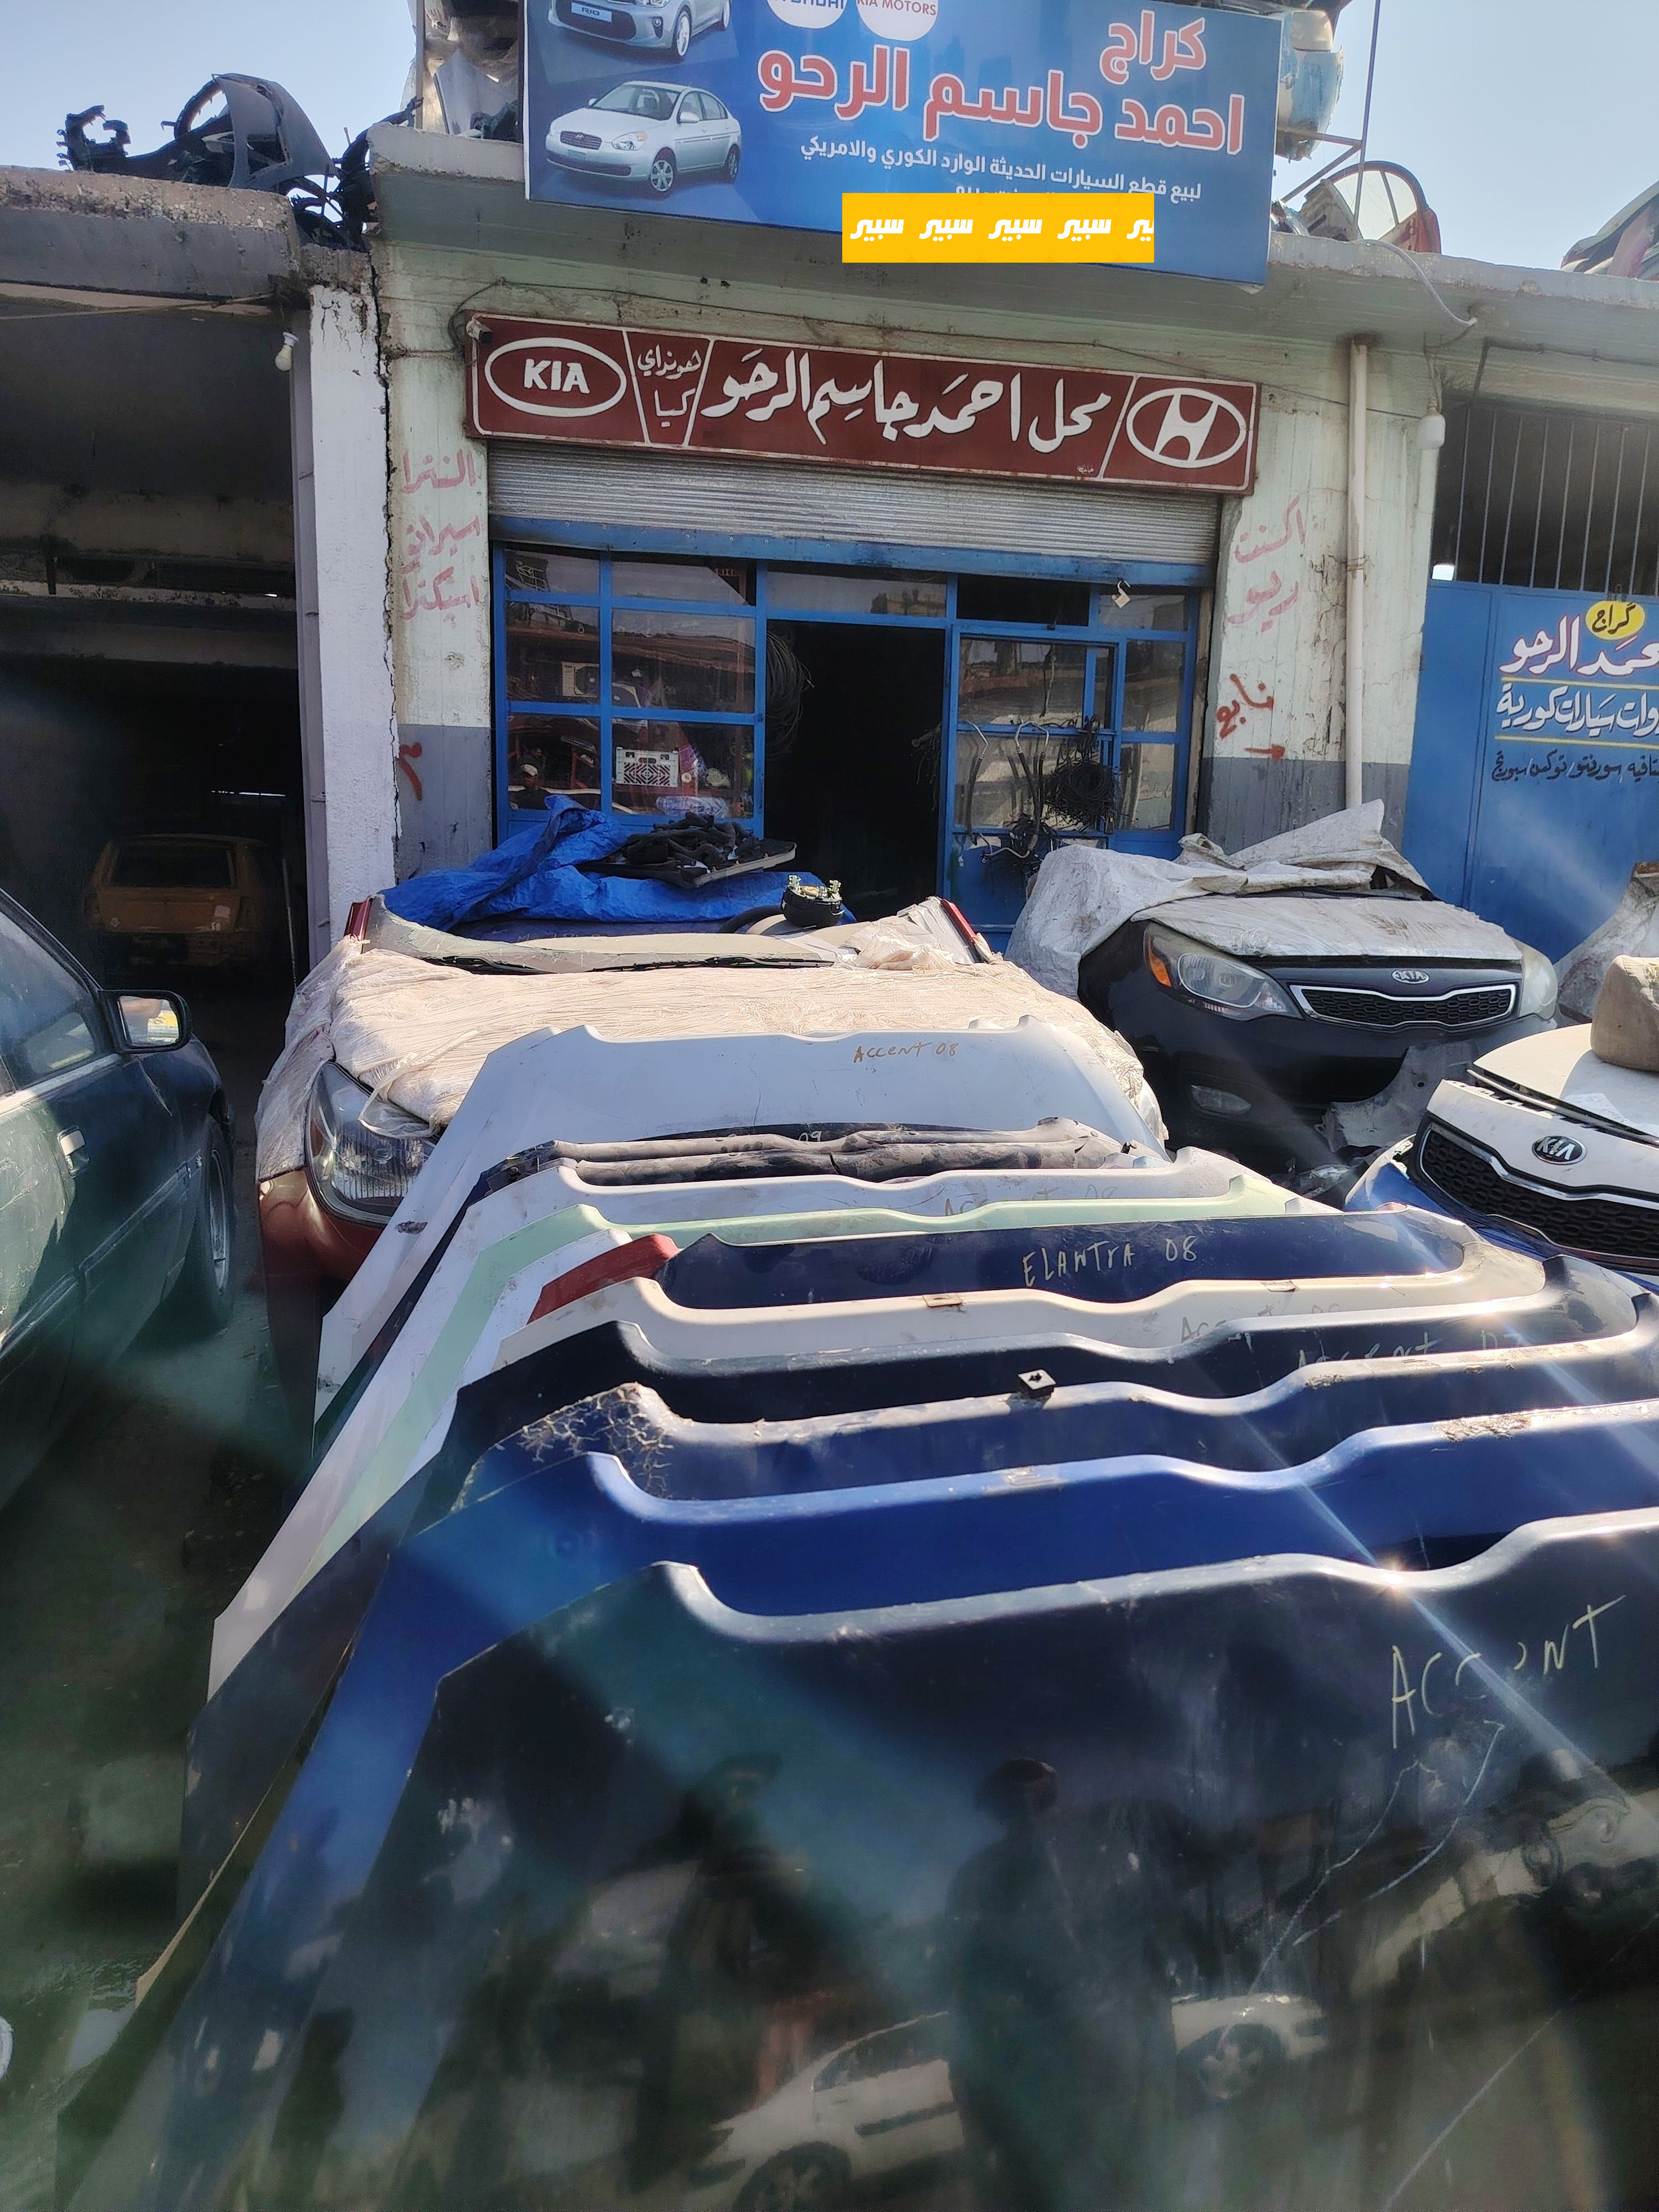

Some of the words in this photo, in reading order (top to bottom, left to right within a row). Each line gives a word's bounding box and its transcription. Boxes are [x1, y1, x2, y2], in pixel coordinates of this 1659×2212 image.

[581, 7, 600, 16] RIO
[882, 0, 936, 15] MOTORS
[1099, 10, 1207, 85] كراج
[757, 44, 910, 121] الرحو
[923, 69, 1103, 149] جاسم
[1114, 93, 1245, 155] احمد
[800, 135, 877, 164] والامريكي
[881, 148, 937, 170] الكوري
[941, 153, 985, 176] الوارد
[989, 155, 1046, 181] الحديثة
[1050, 168, 1124, 191] السيارات
[1128, 176, 1167, 195] قطع
[1170, 183, 1202, 204] لبيع
[523, 358, 590, 394] KIA
[654, 388, 696, 427] كيا
[1029, 378, 1112, 453] محل
[1499, 614, 1580, 674] الرحو
[1496, 682, 1569, 731] كورية
[936, 1043, 959, 1057] 08
[1536, 1137, 1575, 1161] KIA
[1165, 1235, 1198, 1262] 08
